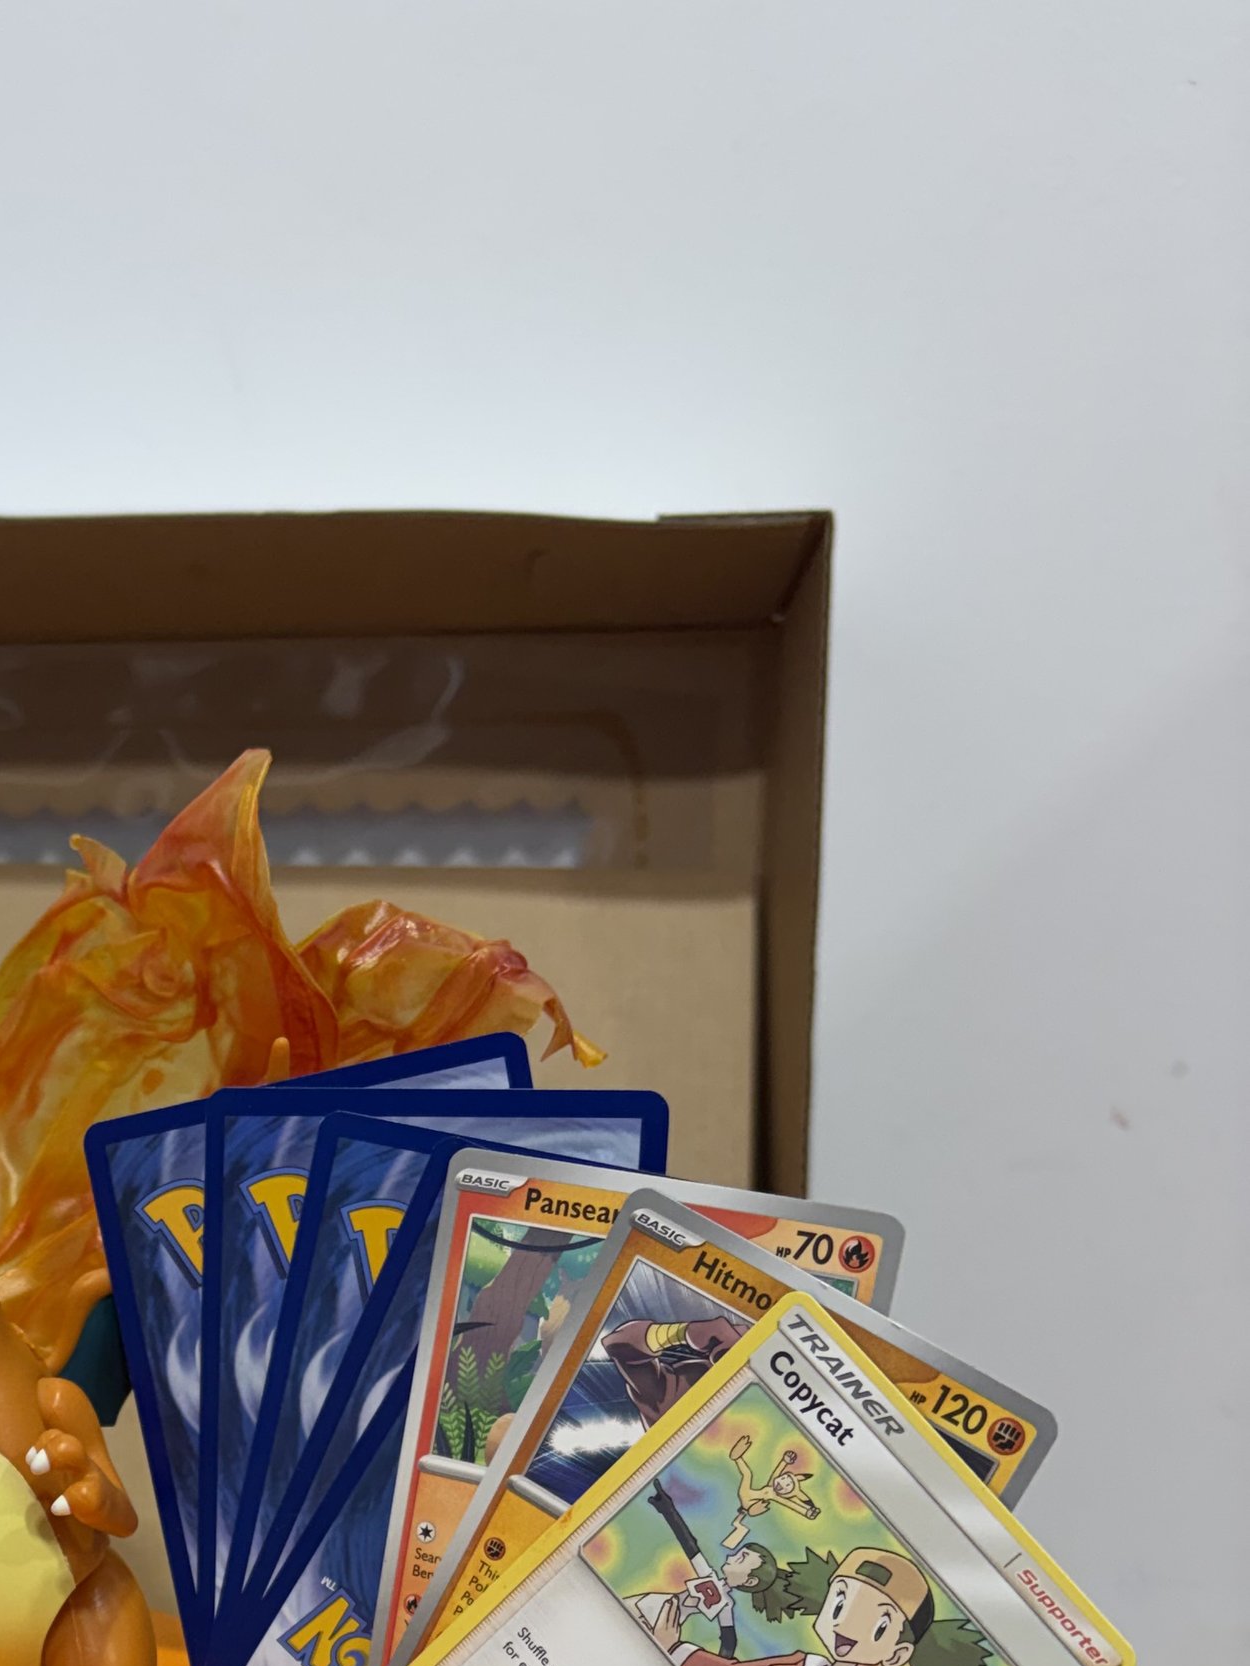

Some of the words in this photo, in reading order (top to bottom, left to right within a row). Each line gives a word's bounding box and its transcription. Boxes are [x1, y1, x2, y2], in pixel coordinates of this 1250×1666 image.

[461, 1173, 511, 1191] BASIC
[635, 1213, 688, 1245] BASIC
[775, 1246, 792, 1259] HP
[792, 1229, 834, 1266] 70
[692, 1251, 776, 1312] Hitmo
[787, 1313, 905, 1436] TRAINER
[770, 1351, 854, 1447] Copycat
[908, 1390, 927, 1405] HP
[930, 1383, 988, 1436] 120
[321, 1576, 336, 1592] TM
[1016, 1569, 1109, 1665] Supporter
[502, 1640, 517, 1658] for
[517, 1627, 550, 1666] Shuffle
